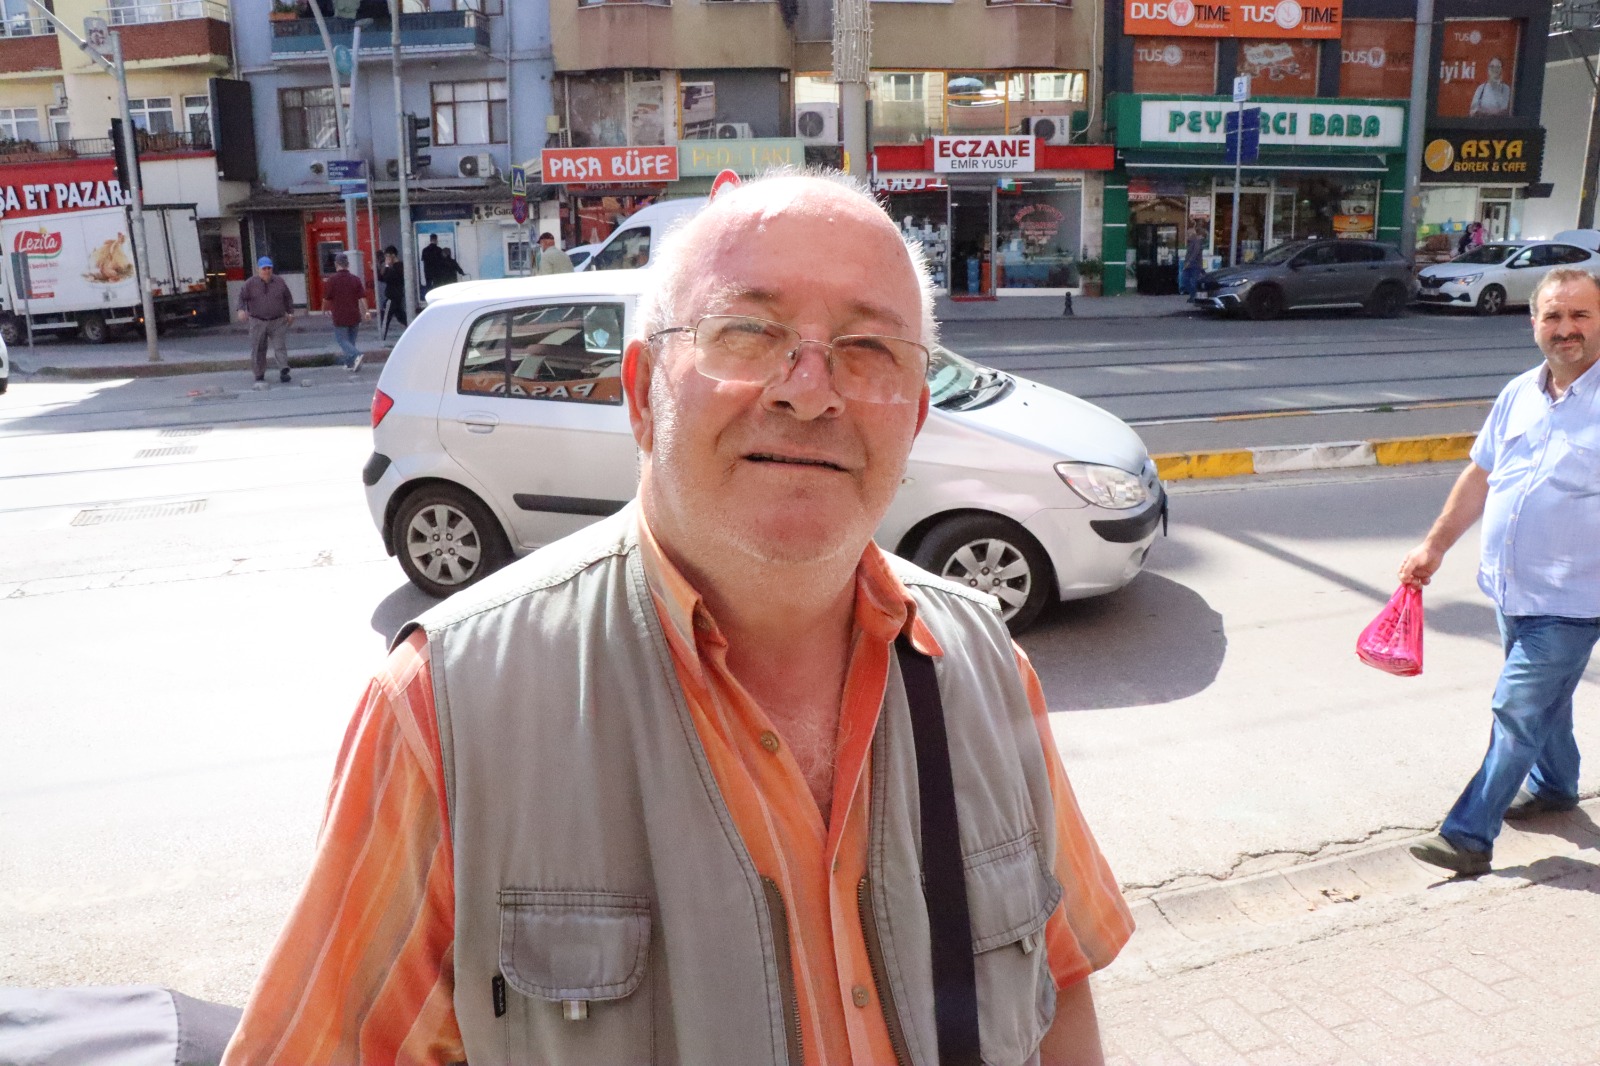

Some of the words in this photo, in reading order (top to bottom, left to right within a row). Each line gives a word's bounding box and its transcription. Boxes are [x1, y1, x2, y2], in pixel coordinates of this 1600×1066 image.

[1131, 2, 1168, 20] DUS
[1195, 4, 1231, 22] TIME
[1240, 5, 1275, 23] TUS
[1302, 6, 1339, 24] TIME
[1454, 32, 1470, 42] TUS
[1137, 49, 1163, 62] TUS
[1341, 50, 1367, 64] DUS
[1440, 60, 1459, 84] iyi
[1461, 60, 1477, 79] ki
[1168, 109, 1297, 136] PEYRCI
[1309, 112, 1380, 138] BABA
[938, 139, 1031, 158] ECZANE
[1461, 140, 1523, 160] ASYA
[549, 156, 603, 180] PAŞA
[611, 149, 670, 176] BÜFE
[950, 158, 979, 169] EMİR
[981, 159, 1018, 169] YUSUF
[1491, 161, 1500, 172] &
[1502, 161, 1528, 172] CAFE
[22, 183, 50, 210] ET
[18, 231, 58, 252] Lezita
